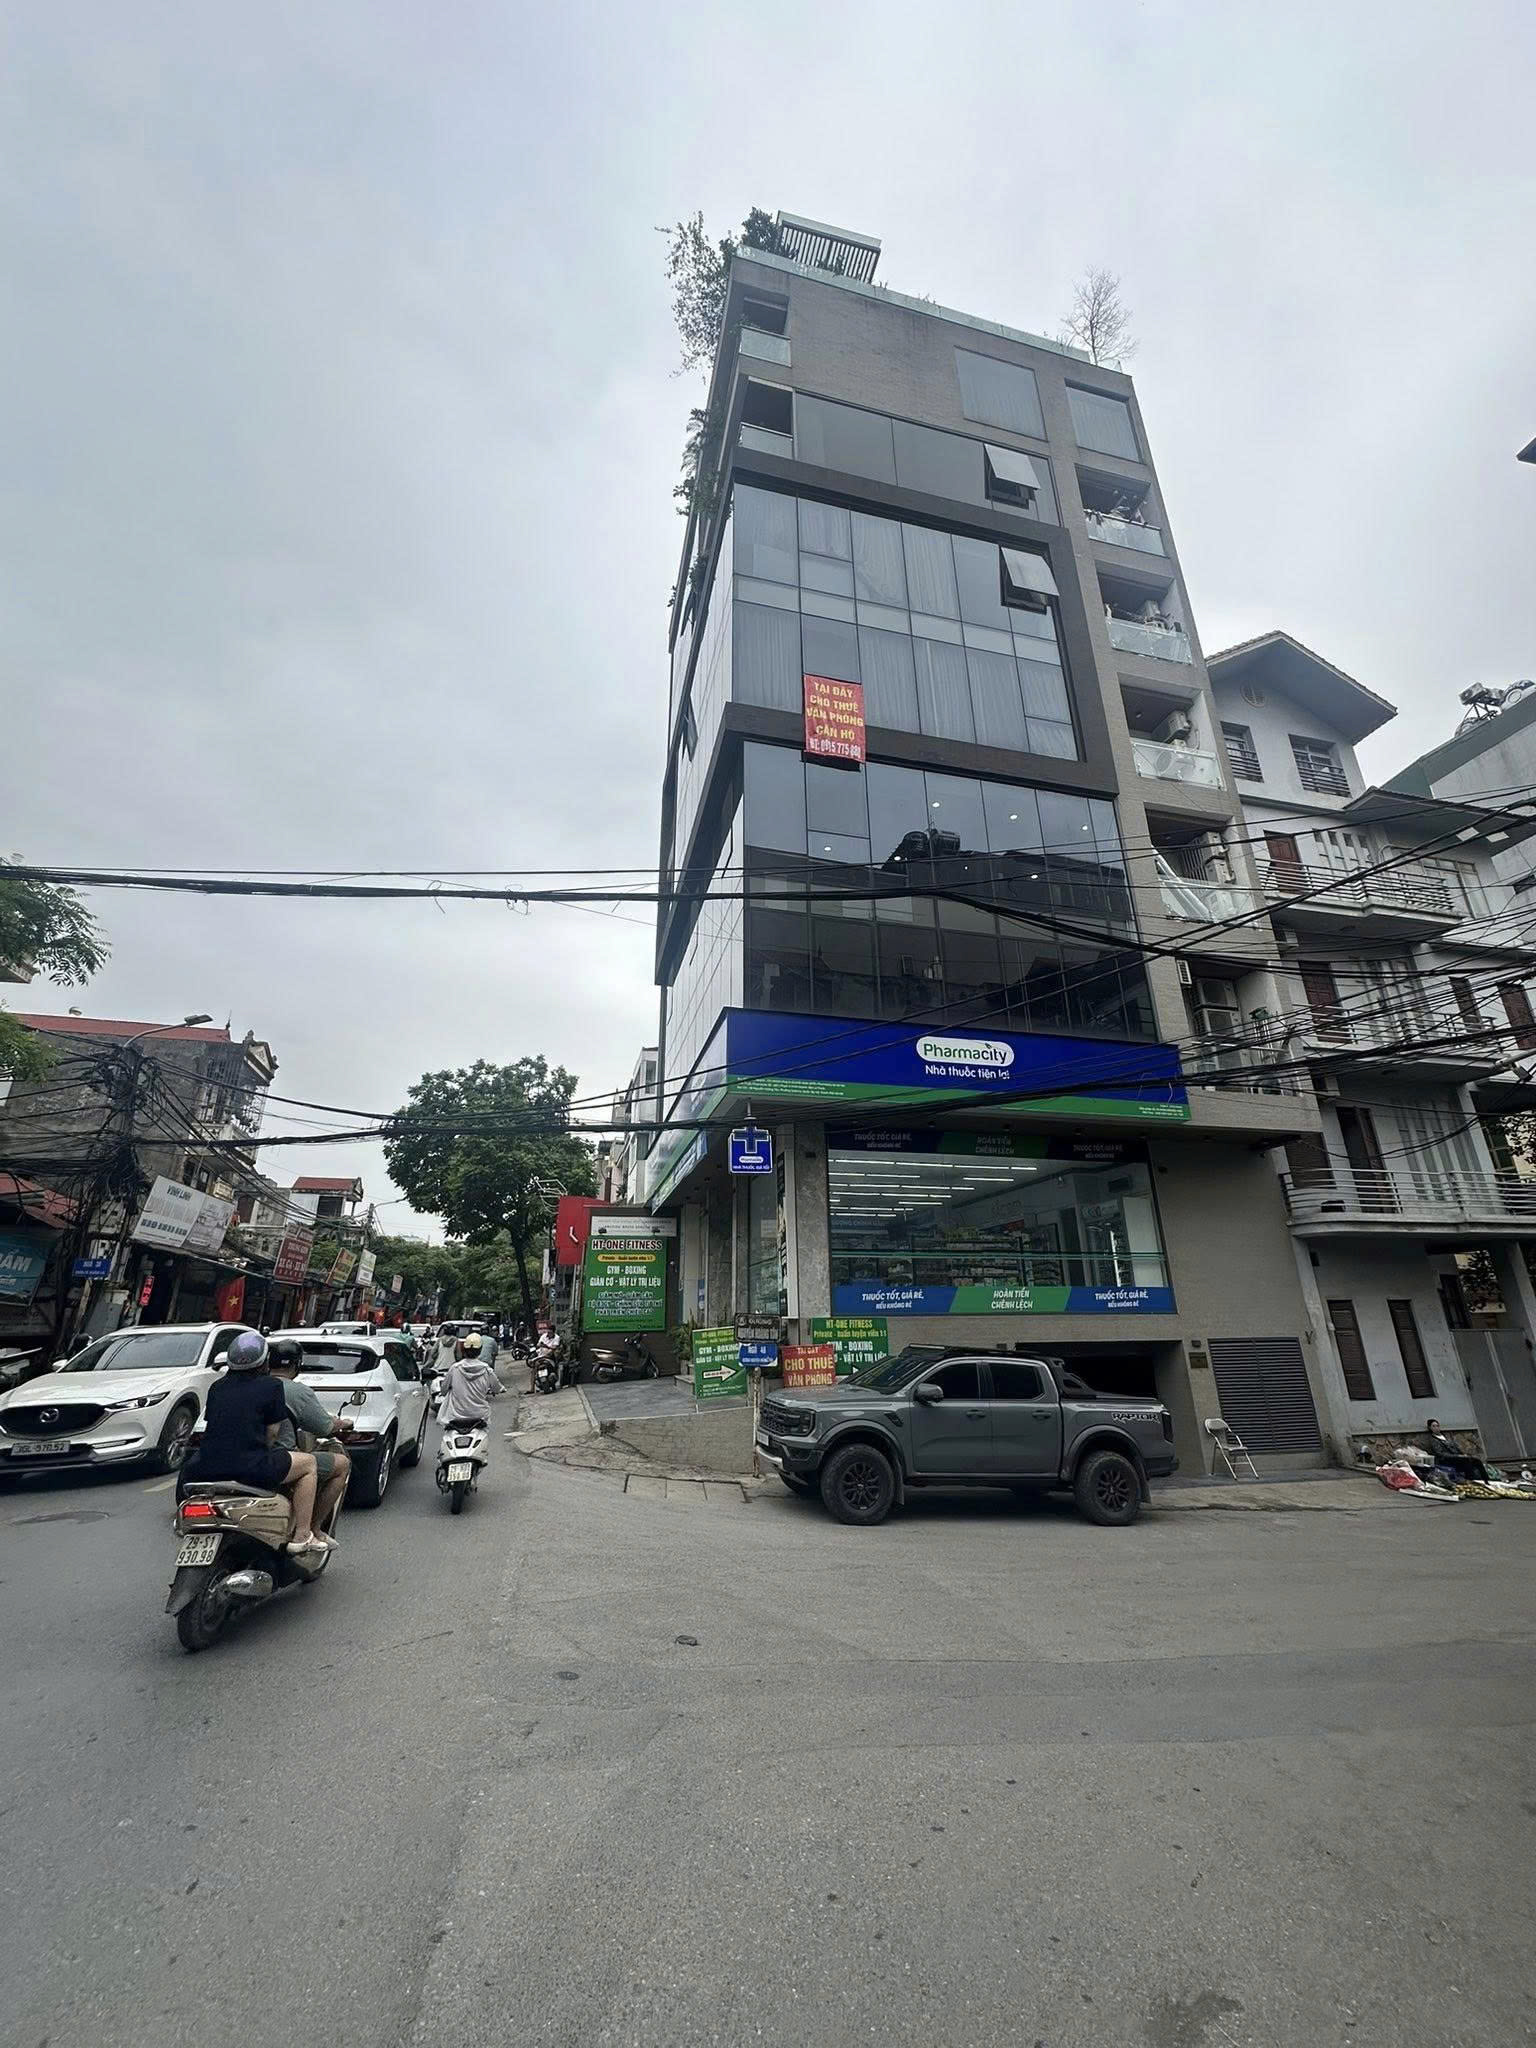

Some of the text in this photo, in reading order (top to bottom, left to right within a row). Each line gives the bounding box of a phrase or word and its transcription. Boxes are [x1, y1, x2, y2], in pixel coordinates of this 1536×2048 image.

[810, 695, 830, 706] CHO
[923, 1042, 1007, 1064] Pharmacity
[925, 1064, 946, 1076] Nhà
[948, 1066, 976, 1078] thuốc
[978, 1068, 996, 1079] tiện
[592, 1239, 662, 1250] HT-ONE FITNESS
[607, 1266, 620, 1274] GYM
[625, 1266, 646, 1274] BOXING
[862, 1290, 885, 1300] THUỐC
[886, 1288, 900, 1300] TỐT,
[902, 1289, 912, 1300] GIÁ
[994, 1287, 1030, 1298] HOÀN TIỀN
[1095, 1290, 1115, 1300] THUỐC
[992, 1298, 1033, 1310] CHÊNH LỆCH
[849, 1319, 872, 1328] FITNESS
[848, 1341, 873, 1351] BOXING
[785, 1359, 805, 1370] CHO
[807, 1354, 834, 1370] THUÊ
[844, 1352, 855, 1363] VẬT
[864, 1353, 874, 1363] TRỊ
[1112, 1412, 1160, 1424] RAPTOR
[186, 1536, 216, 1550] 29-S1
[177, 1550, 214, 1564] 930.98
